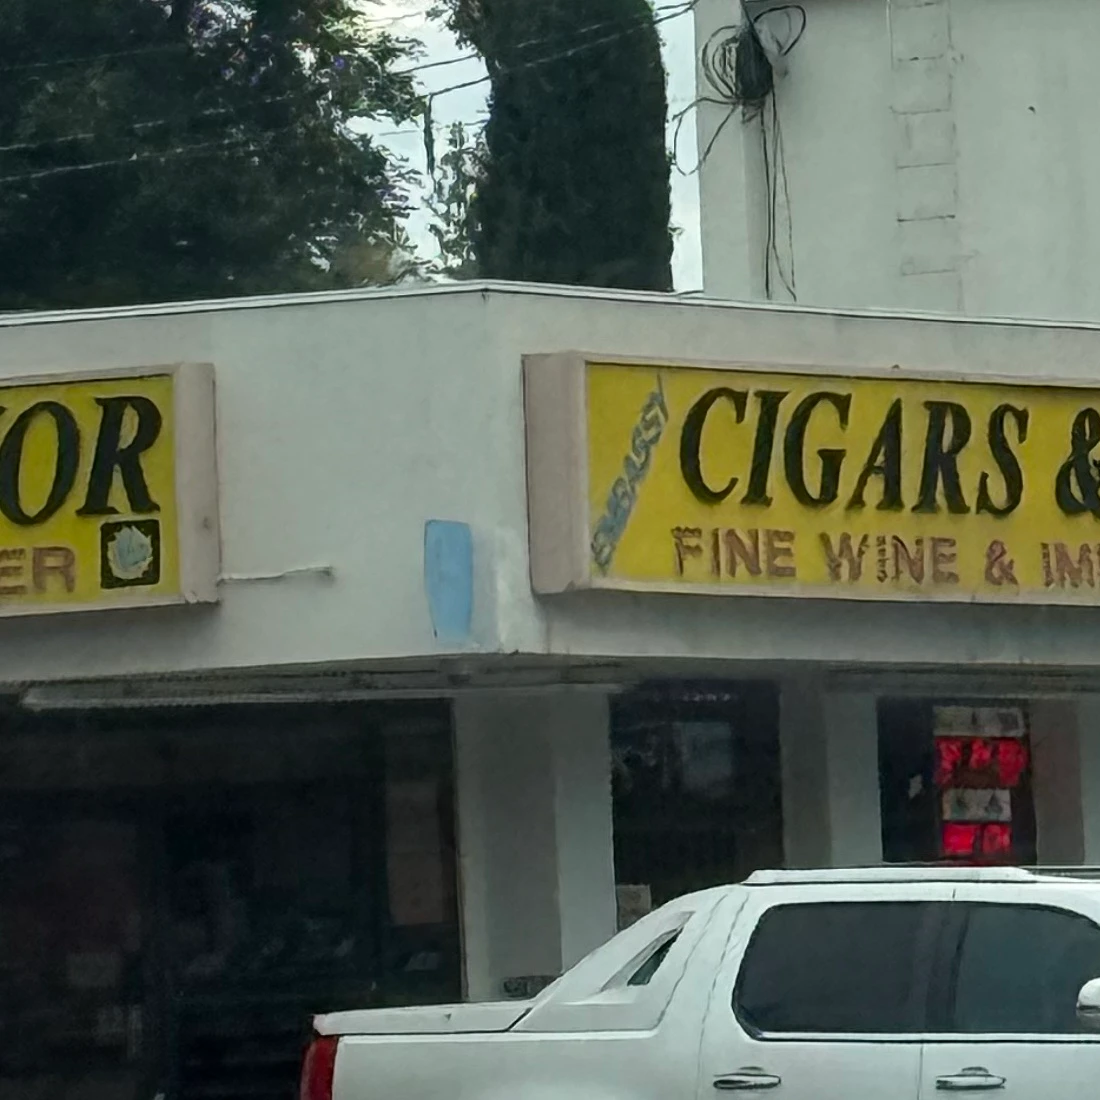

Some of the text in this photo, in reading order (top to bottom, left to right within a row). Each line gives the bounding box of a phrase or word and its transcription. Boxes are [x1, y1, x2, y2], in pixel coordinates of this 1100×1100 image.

[0, 395, 162, 526] OR
[680, 387, 1028, 516] CIGARS
[671, 525, 796, 578] FINE
[820, 532, 960, 585] WINE
[985, 538, 1019, 586] &
